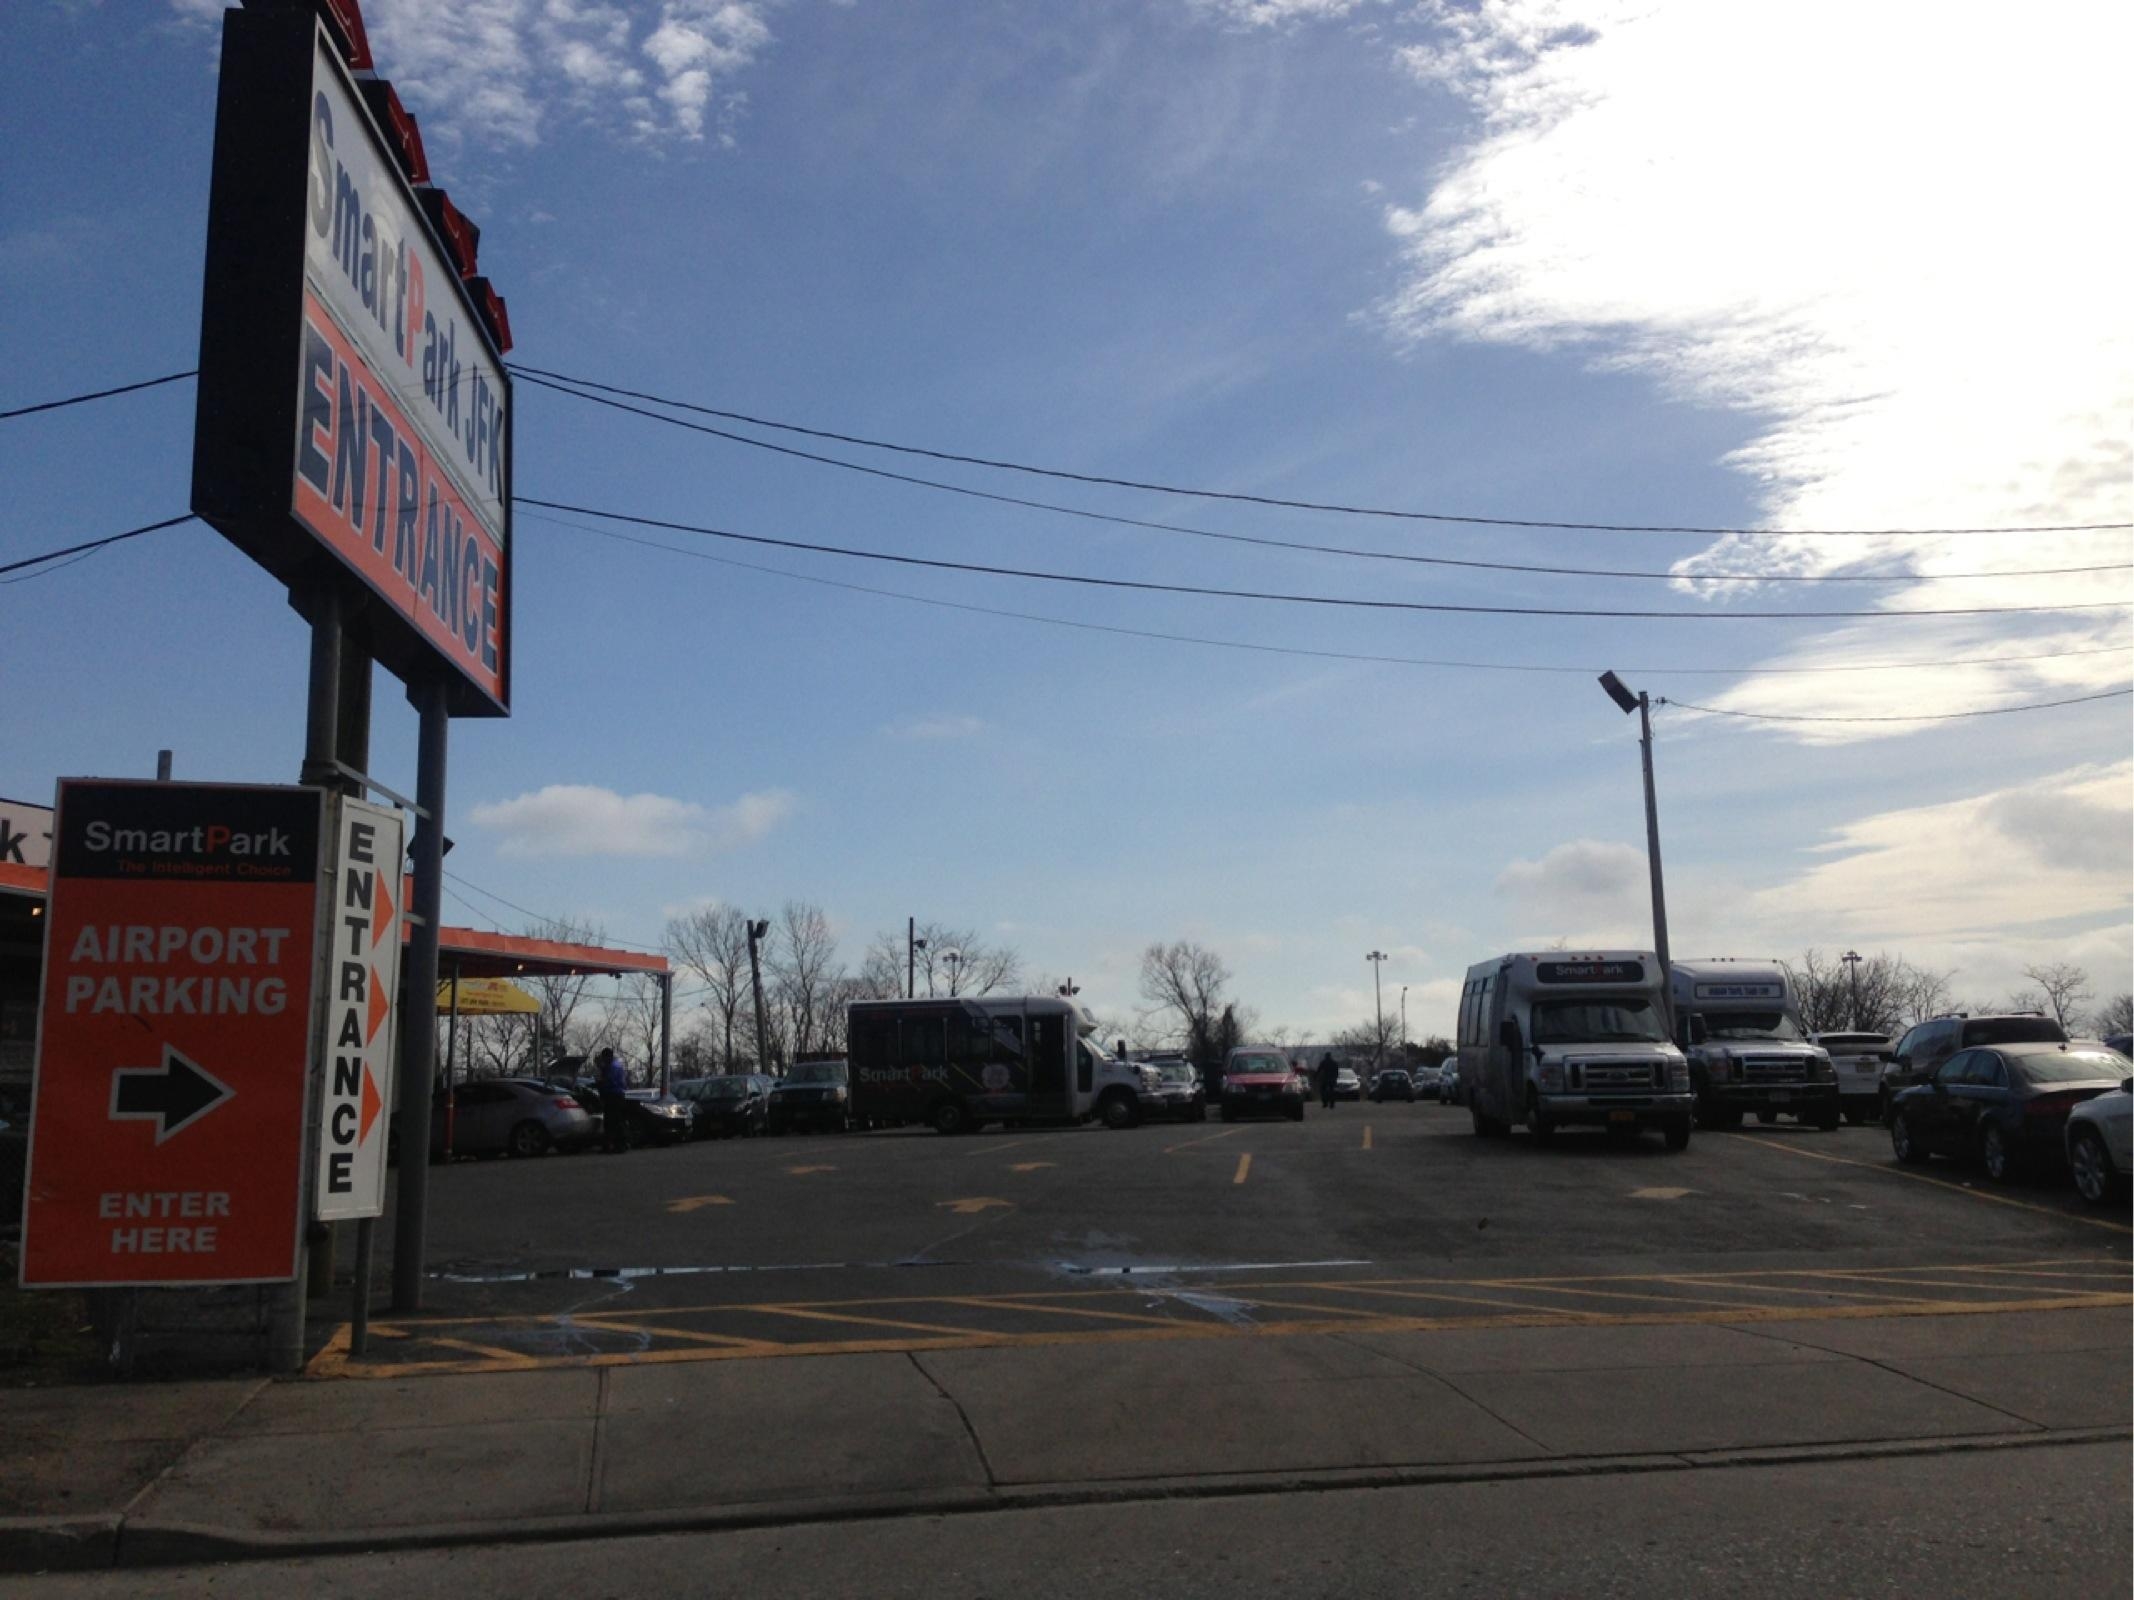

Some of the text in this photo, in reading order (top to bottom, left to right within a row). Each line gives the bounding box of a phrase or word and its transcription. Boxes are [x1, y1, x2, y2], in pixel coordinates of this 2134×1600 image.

[310, 90, 503, 505] SmartPark JFK
[298, 316, 499, 677] ENTRANCE
[84, 820, 291, 856] SmartPark
[118, 858, 292, 877] The Intelligent Choice
[70, 925, 291, 965] AIRPORT
[65, 976, 288, 1015] PARKING
[327, 821, 376, 1194] ENTRANCE
[100, 1192, 231, 1219] ENTER
[111, 1227, 218, 1254] HERE
